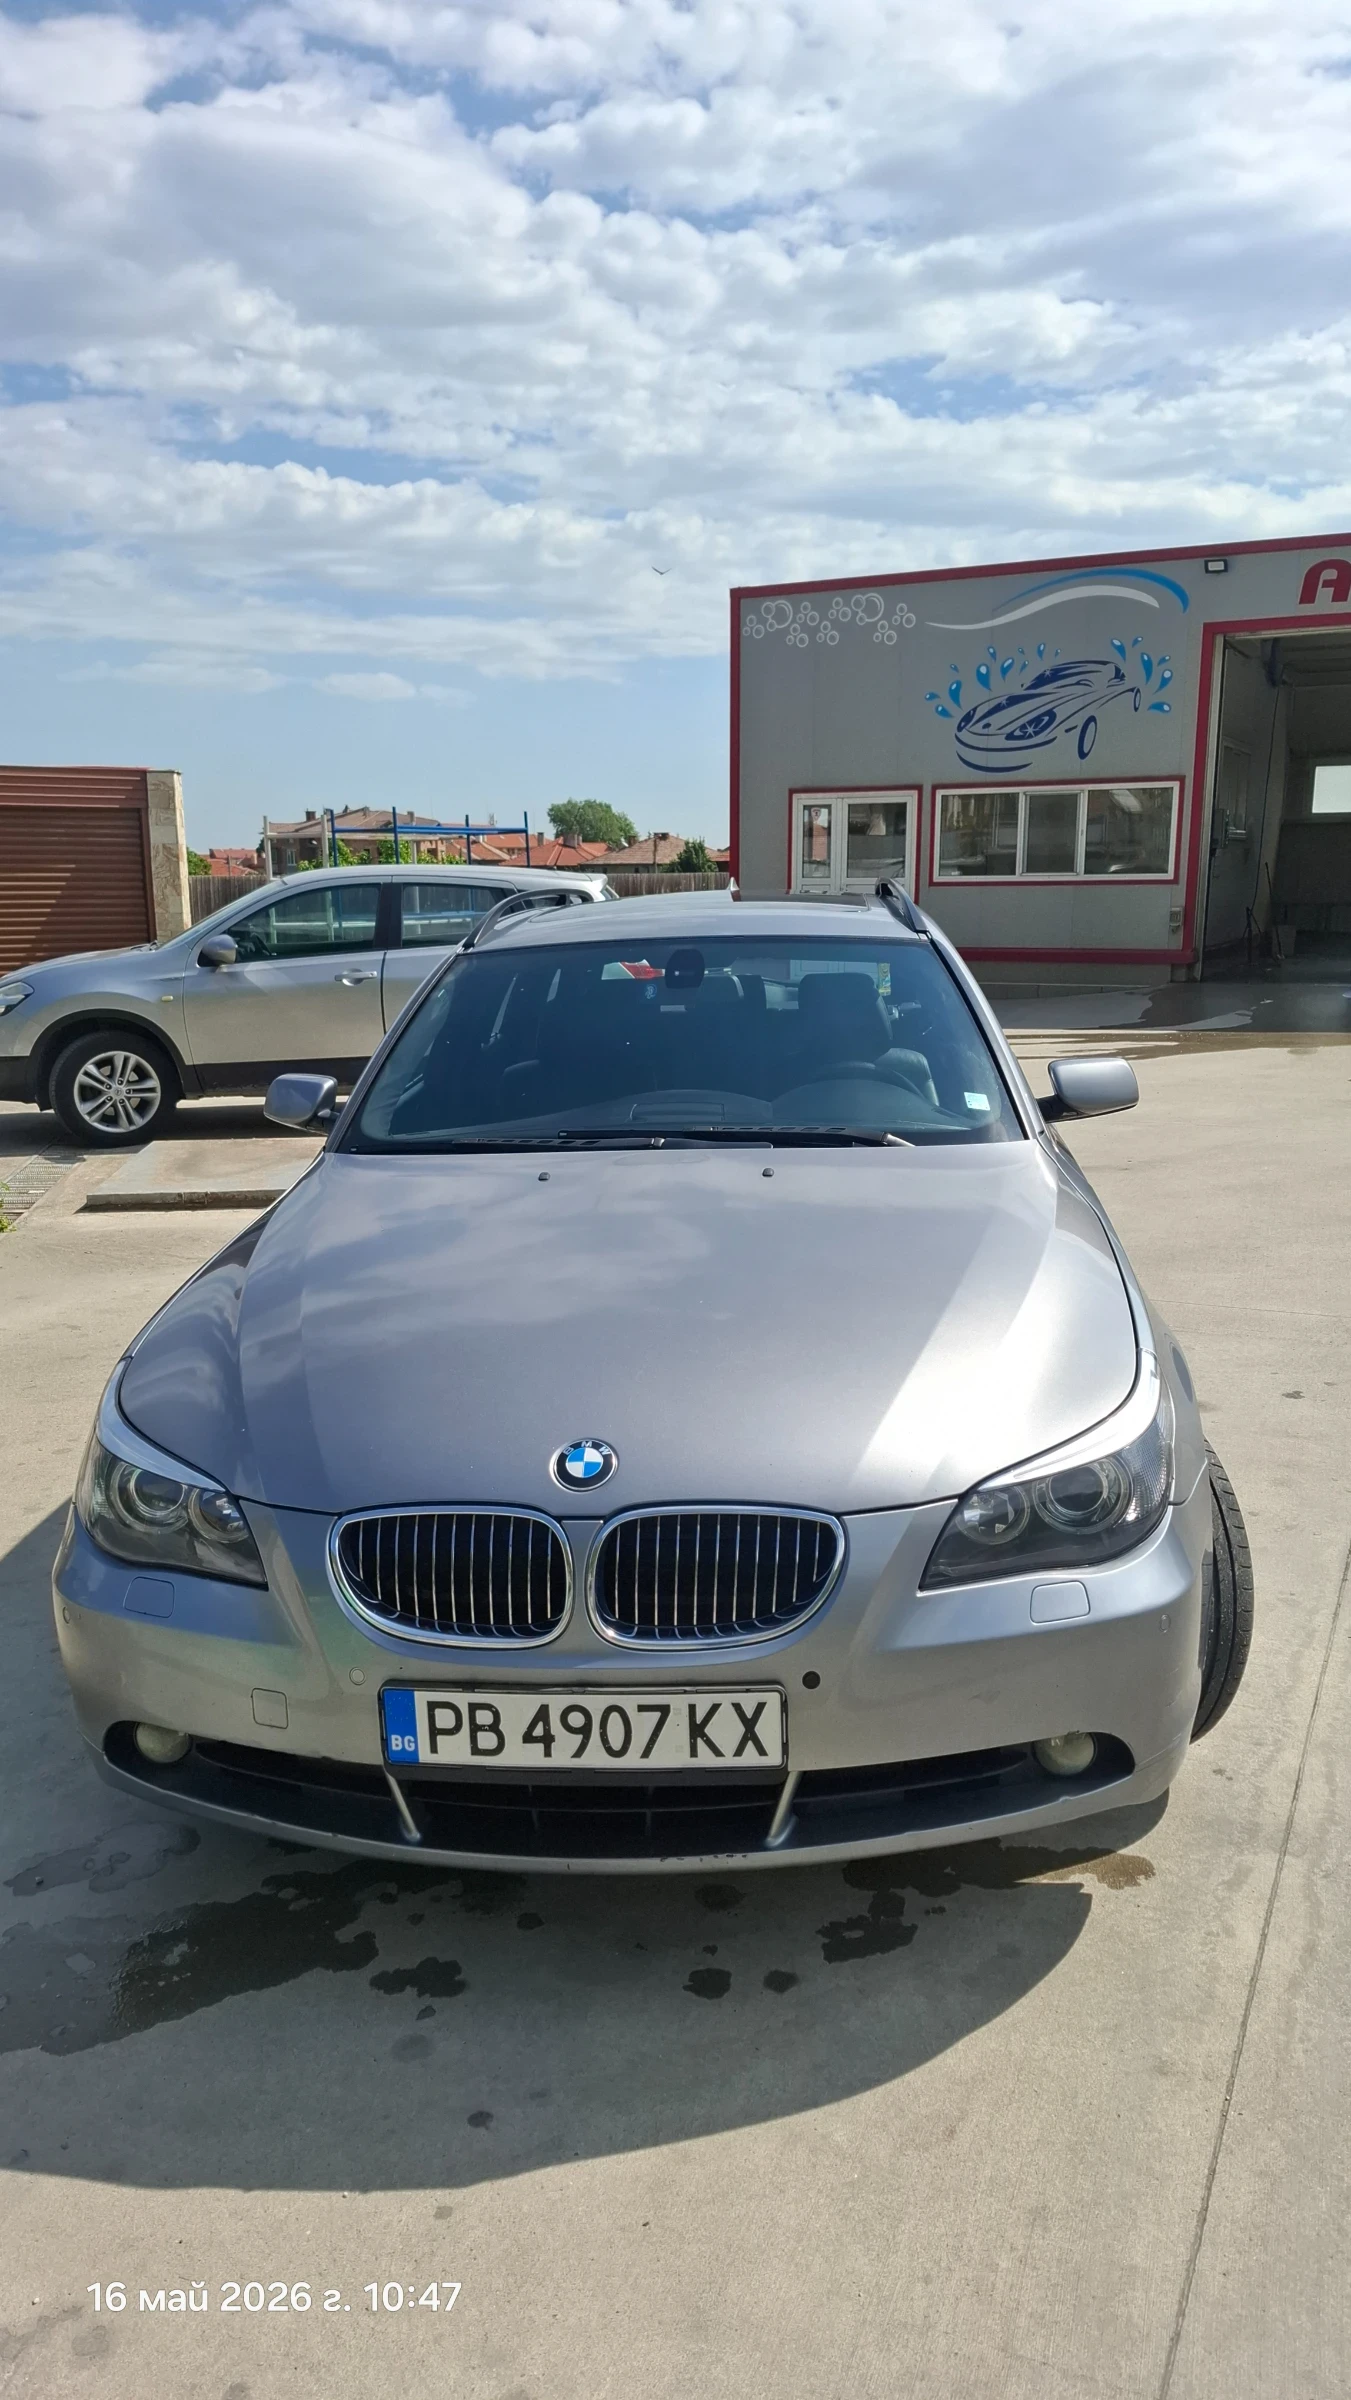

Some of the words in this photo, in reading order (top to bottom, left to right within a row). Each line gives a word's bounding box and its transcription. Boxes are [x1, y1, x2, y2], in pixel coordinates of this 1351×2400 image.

[563, 1440, 612, 1456] BMW
[426, 1700, 506, 1757] PB
[521, 1703, 672, 1759] 4907
[687, 1701, 769, 1758] KX
[391, 1734, 416, 1752] BG
